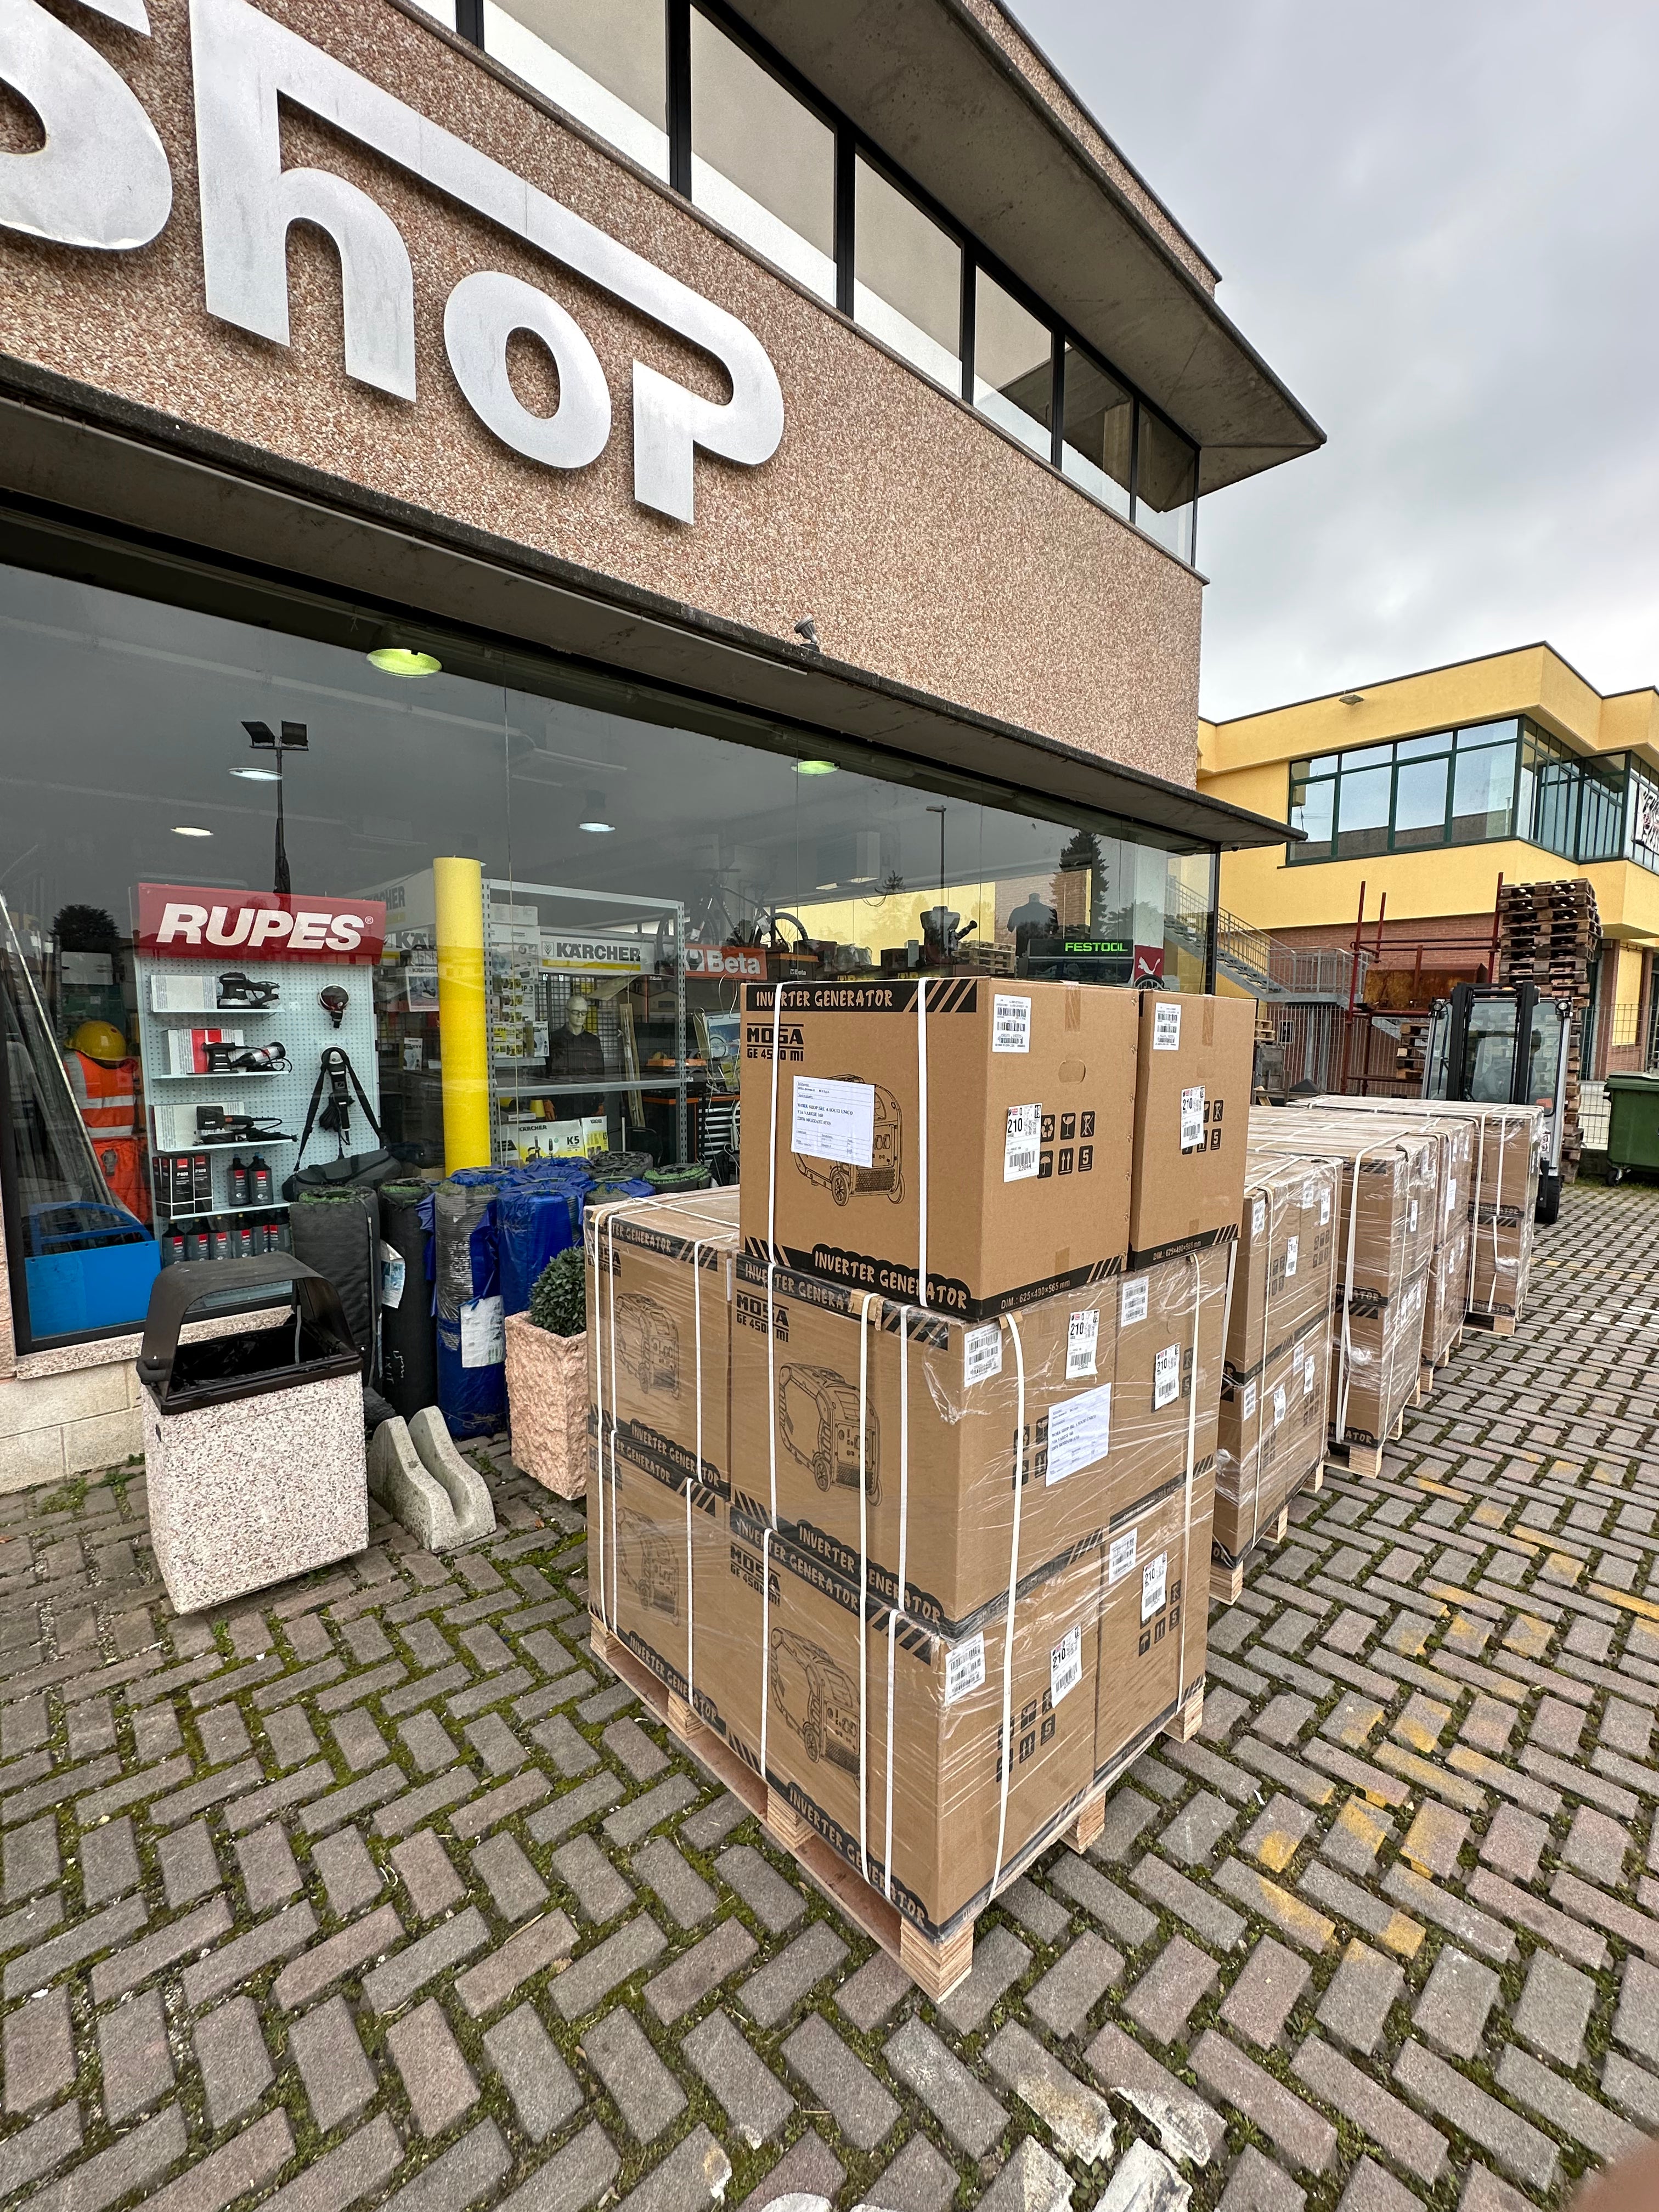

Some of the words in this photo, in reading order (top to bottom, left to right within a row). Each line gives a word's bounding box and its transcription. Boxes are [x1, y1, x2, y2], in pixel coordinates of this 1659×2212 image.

[157, 903, 365, 950] RUPES
[556, 943, 641, 962] KÄRCHER
[1065, 943, 1128, 951] FESTOOL
[707, 950, 760, 974] Beta
[815, 989, 893, 1007] GENERATOR
[747, 1048, 758, 1059] GE
[1183, 1097, 1193, 1110] 210
[1007, 1118, 1023, 1133] 210
[567, 1136, 580, 1146] K5
[815, 1250, 874, 1283] INVERTER
[1059, 1280, 1070, 1289] mm
[737, 1313, 747, 1326] GE
[1070, 1322, 1084, 1336] 210
[1157, 1358, 1167, 1373] 210
[631, 1423, 667, 1456] INVERTER
[627, 1446, 671, 1484] GENERATOR
[790, 1554, 858, 1611] GENERATOR
[799, 1525, 855, 1574] INVERTER
[868, 1568, 941, 1625] ENERATOR
[1145, 1568, 1155, 1585] 210
[630, 1635, 665, 1678] INVERTER
[1053, 1647, 1066, 1669] 210
[789, 1787, 843, 1851] INVERTER
